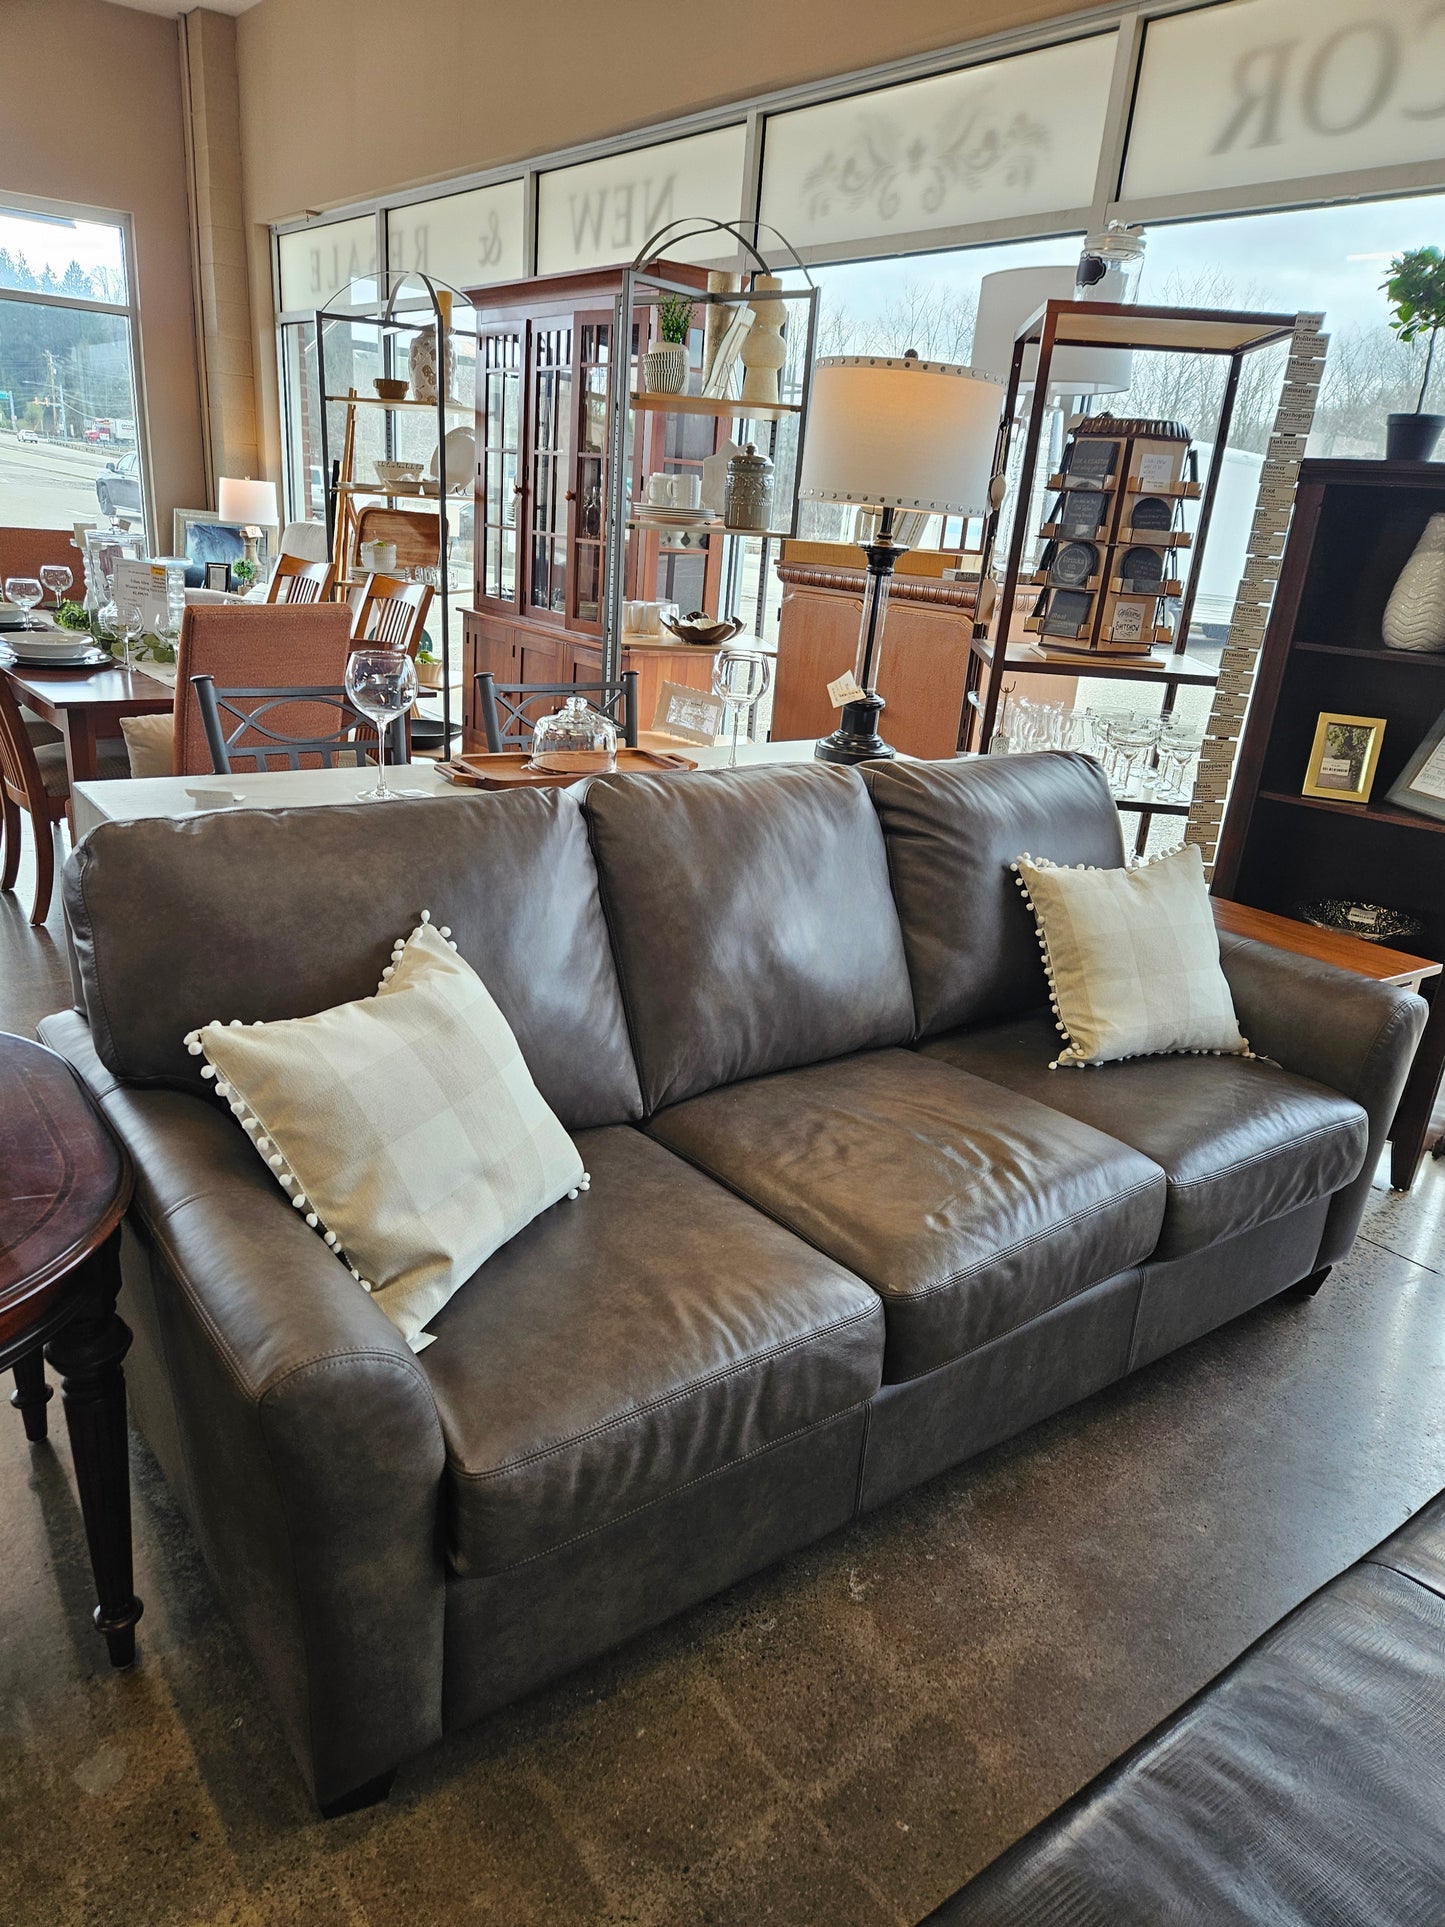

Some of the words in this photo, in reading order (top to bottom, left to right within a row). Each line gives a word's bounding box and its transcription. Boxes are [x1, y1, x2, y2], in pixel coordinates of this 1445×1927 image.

[1295, 335, 1325, 343] Politeness
[1291, 360, 1316, 368] Whatever
[1280, 411, 1311, 419] Psychopath
[1237, 605, 1261, 613] Sarcasm
[1225, 651, 1250, 659] Pessimist
[1201, 761, 1229, 769] Happiness
